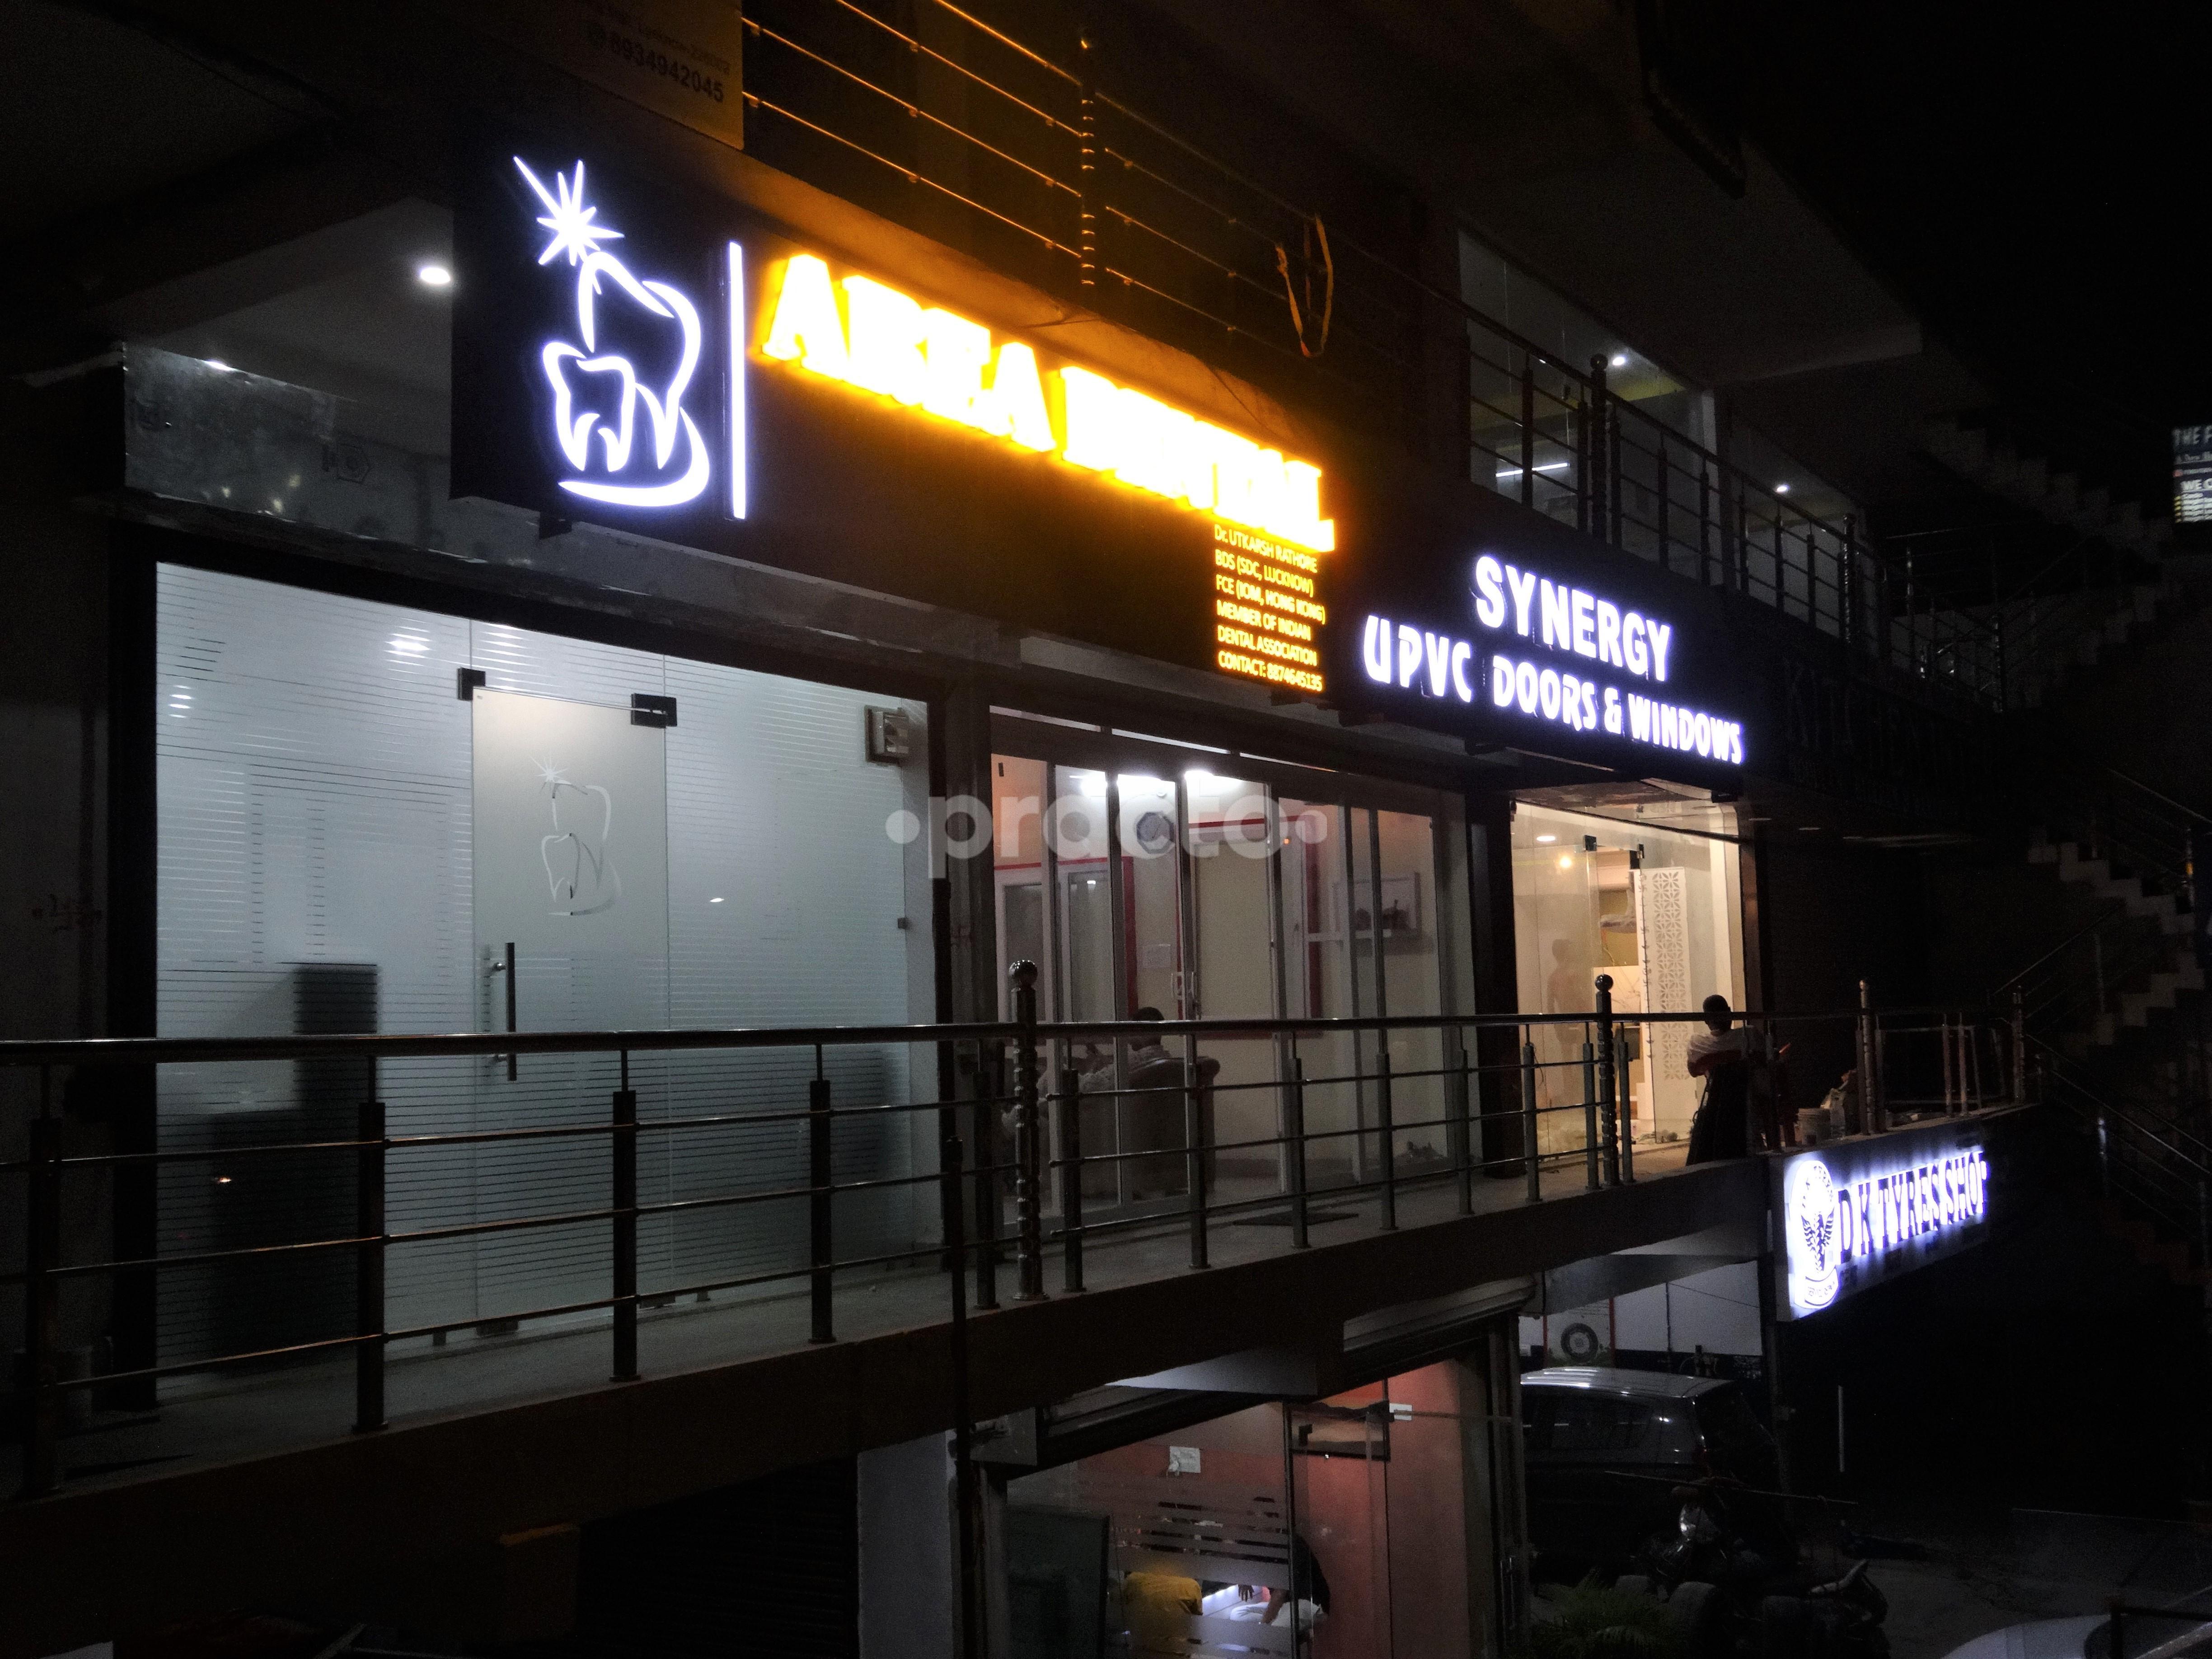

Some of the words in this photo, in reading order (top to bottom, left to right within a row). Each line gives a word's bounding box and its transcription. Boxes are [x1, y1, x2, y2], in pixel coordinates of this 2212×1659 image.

[1214, 524, 1228, 543] Dr.
[1228, 529, 1275, 558] UTKARSH
[1275, 544, 1318, 573] RATHORE
[1215, 549, 1236, 570] BDS
[1263, 565, 1314, 598] LUCKNOW)
[1216, 574, 1235, 595] FCE
[1265, 589, 1296, 613] HONG
[1296, 599, 1326, 625] KONG)
[1216, 599, 1262, 627] MEMBER
[1262, 613, 1277, 630] OF
[1277, 617, 1311, 641] INDIAN
[1475, 555, 1671, 682] SYNERGY
[1217, 625, 1256, 650] DENTAL
[1256, 636, 1317, 666] ASSOCIATION
[1218, 650, 1266, 678] CONTACT:
[1363, 614, 1472, 704] UPVC
[1492, 654, 1597, 731] DOORS
[1604, 687, 1623, 736] &
[1627, 693, 1743, 765] WINDOWS
